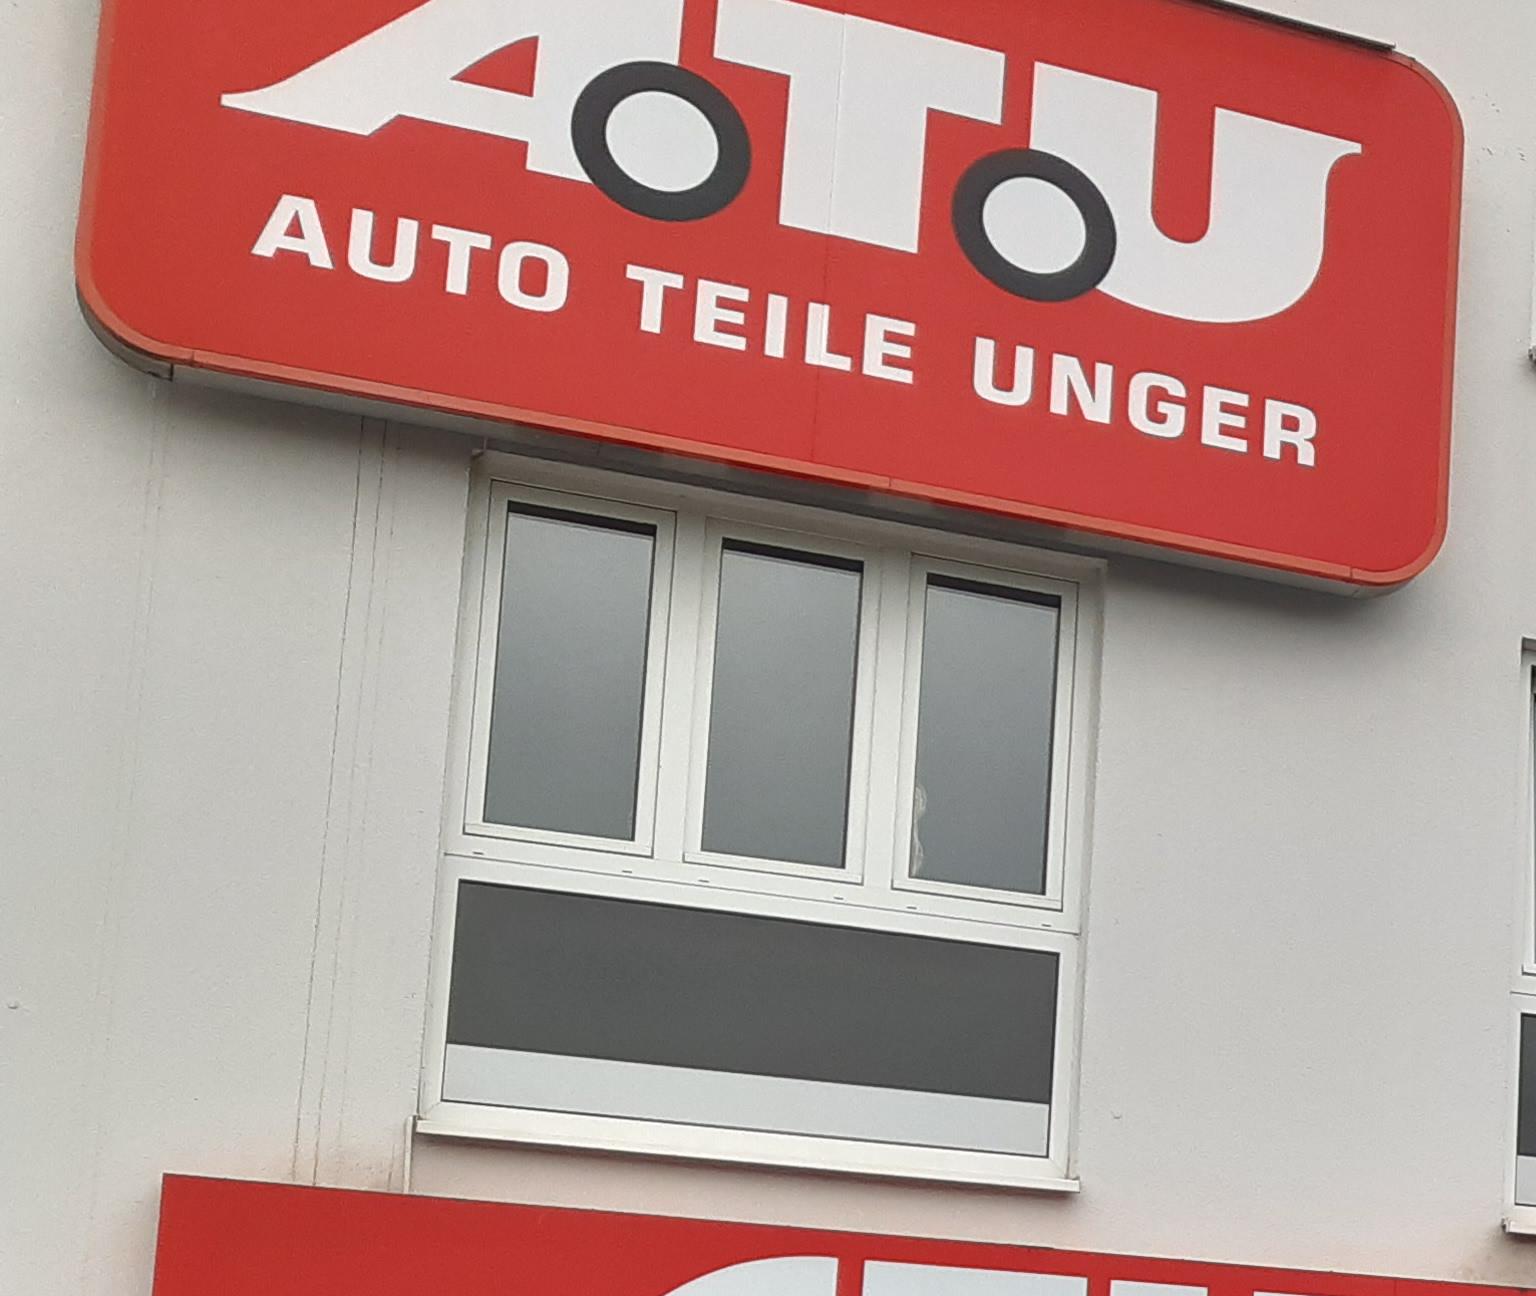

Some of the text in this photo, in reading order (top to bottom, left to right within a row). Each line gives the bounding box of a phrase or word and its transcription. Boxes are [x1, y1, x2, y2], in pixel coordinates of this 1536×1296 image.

[251, 193, 1320, 467] AUTO TEILE UNGER
